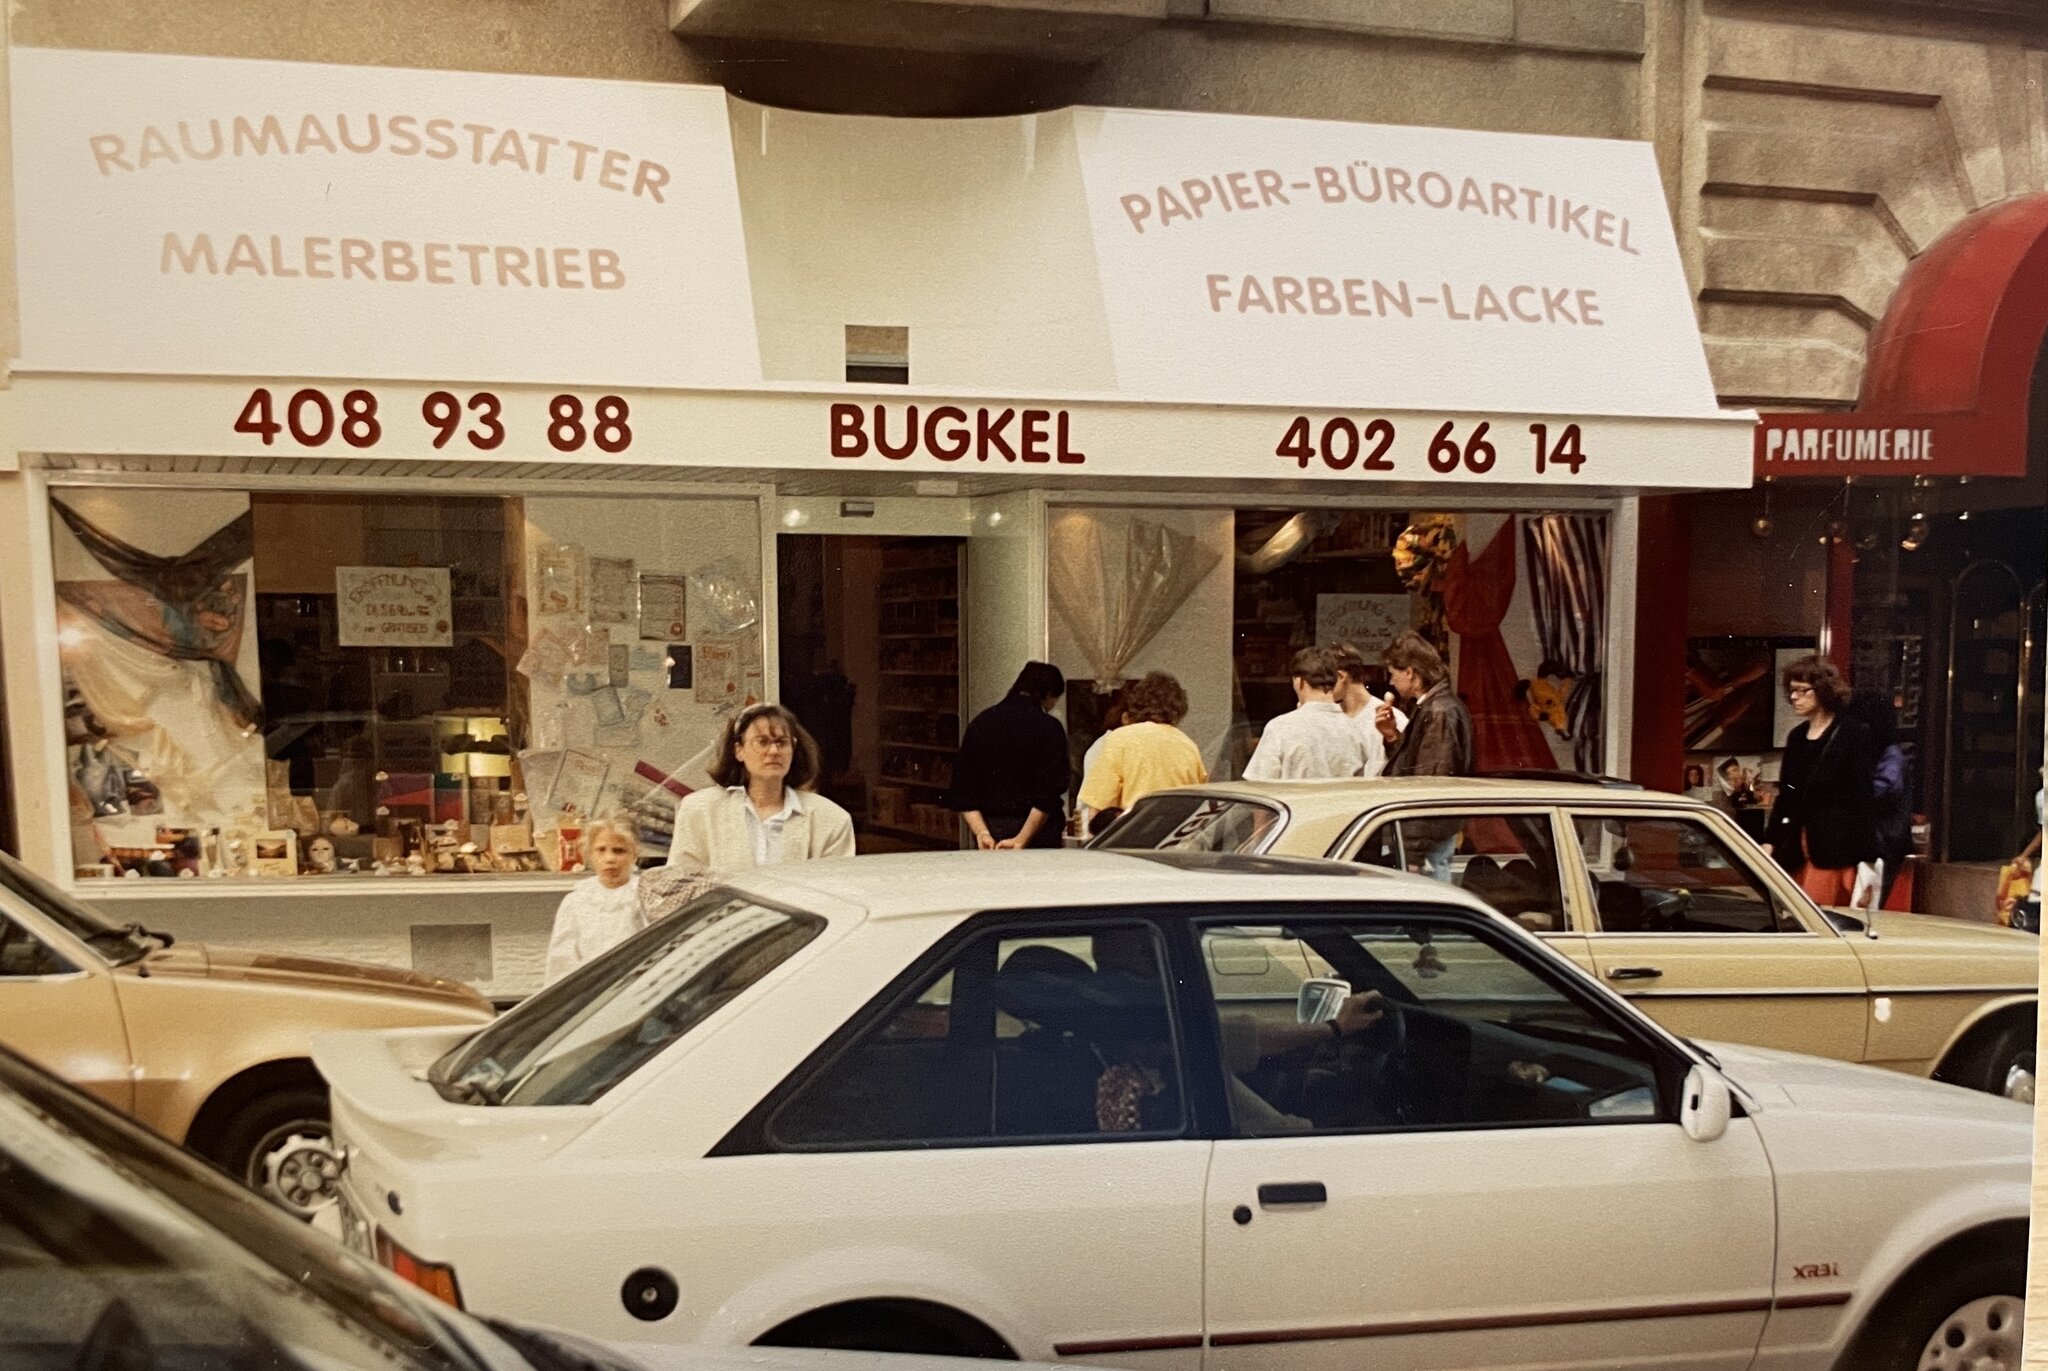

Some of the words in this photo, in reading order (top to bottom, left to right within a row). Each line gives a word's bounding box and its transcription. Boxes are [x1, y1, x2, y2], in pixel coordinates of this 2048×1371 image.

[90, 113, 671, 204] RAUMAUSSTATTER
[1119, 161, 1640, 255] PAPIER-BÜROARTIKEL
[161, 233, 626, 290] MALERBETRIEB
[1206, 273, 1604, 326] FARBEN-LACKE
[234, 388, 382, 448] 408
[422, 391, 505, 450] 93
[547, 394, 632, 453] 88
[830, 403, 1086, 464] BUGKEL
[1275, 416, 1395, 471] 402
[1427, 421, 1496, 474] 66
[1529, 423, 1587, 474] 14
[1766, 428, 1934, 461] PARFUMERIE
